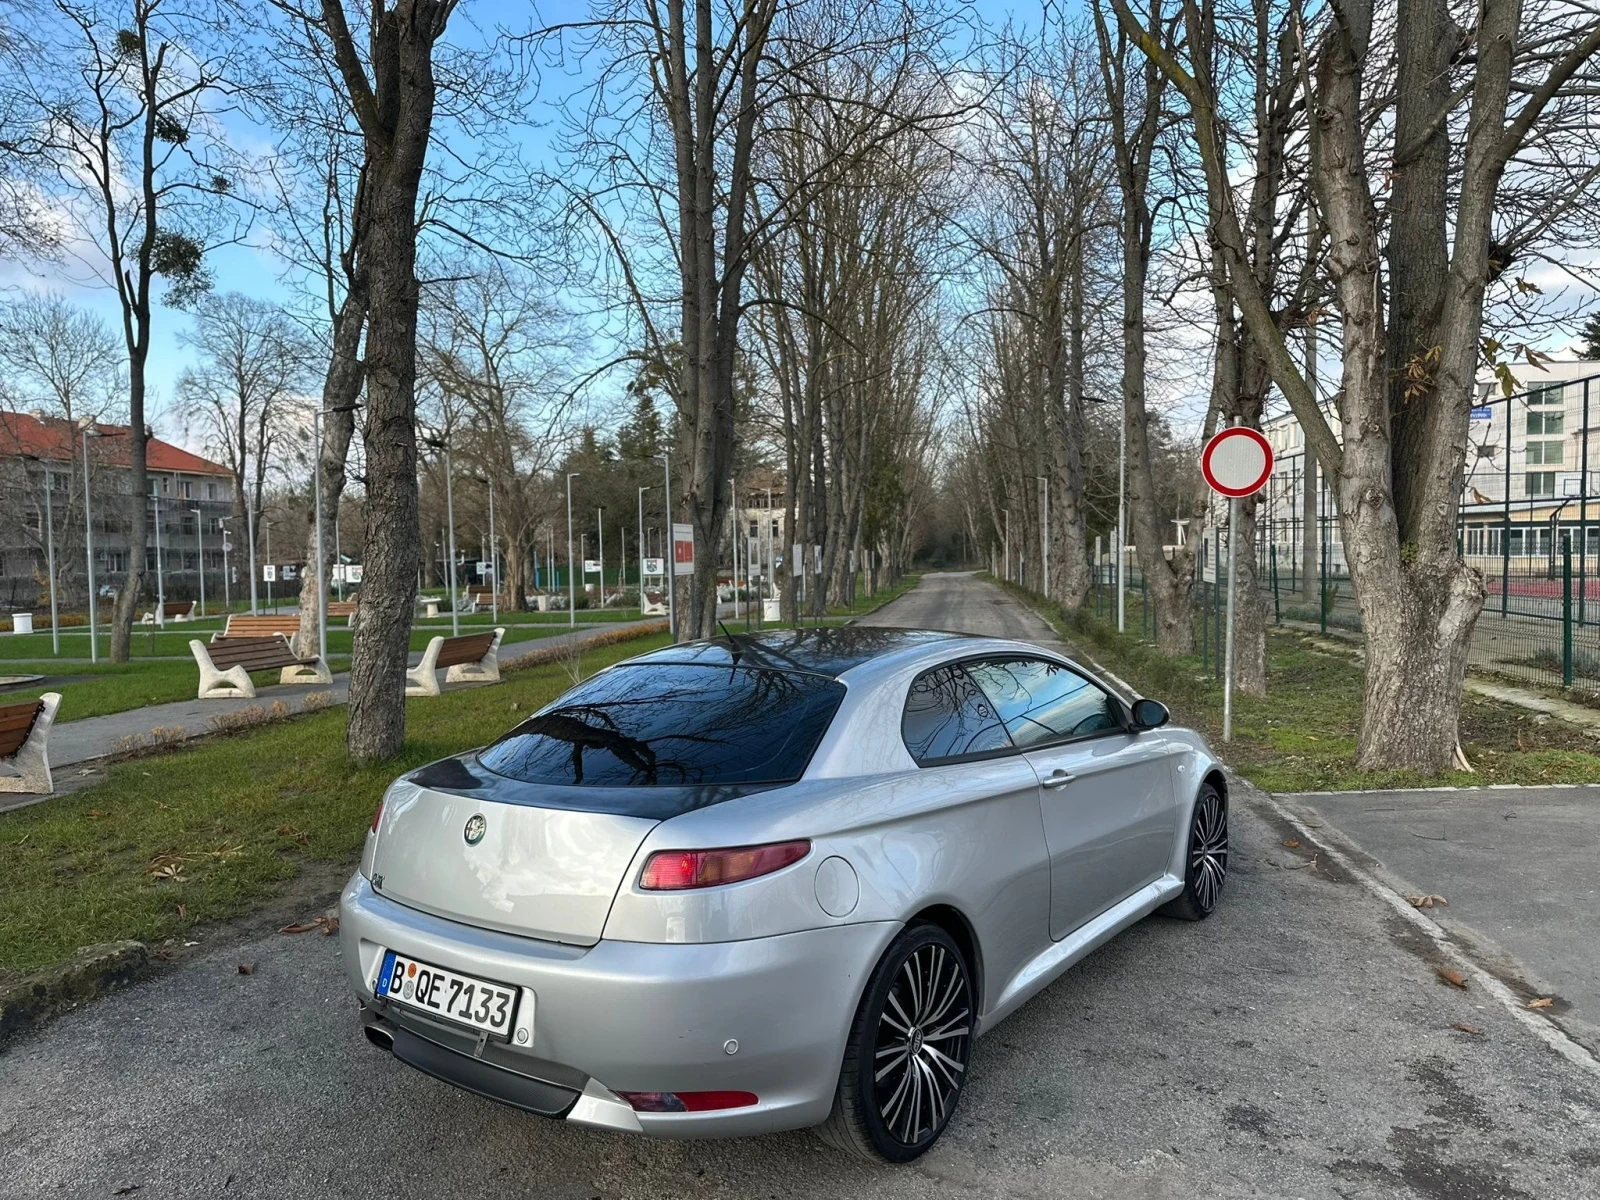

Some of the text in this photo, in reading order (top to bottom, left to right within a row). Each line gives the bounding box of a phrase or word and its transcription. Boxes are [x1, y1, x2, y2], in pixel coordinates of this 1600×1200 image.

[382, 978, 387, 988] D
[390, 961, 405, 994] B
[446, 979, 510, 1027] 7133
